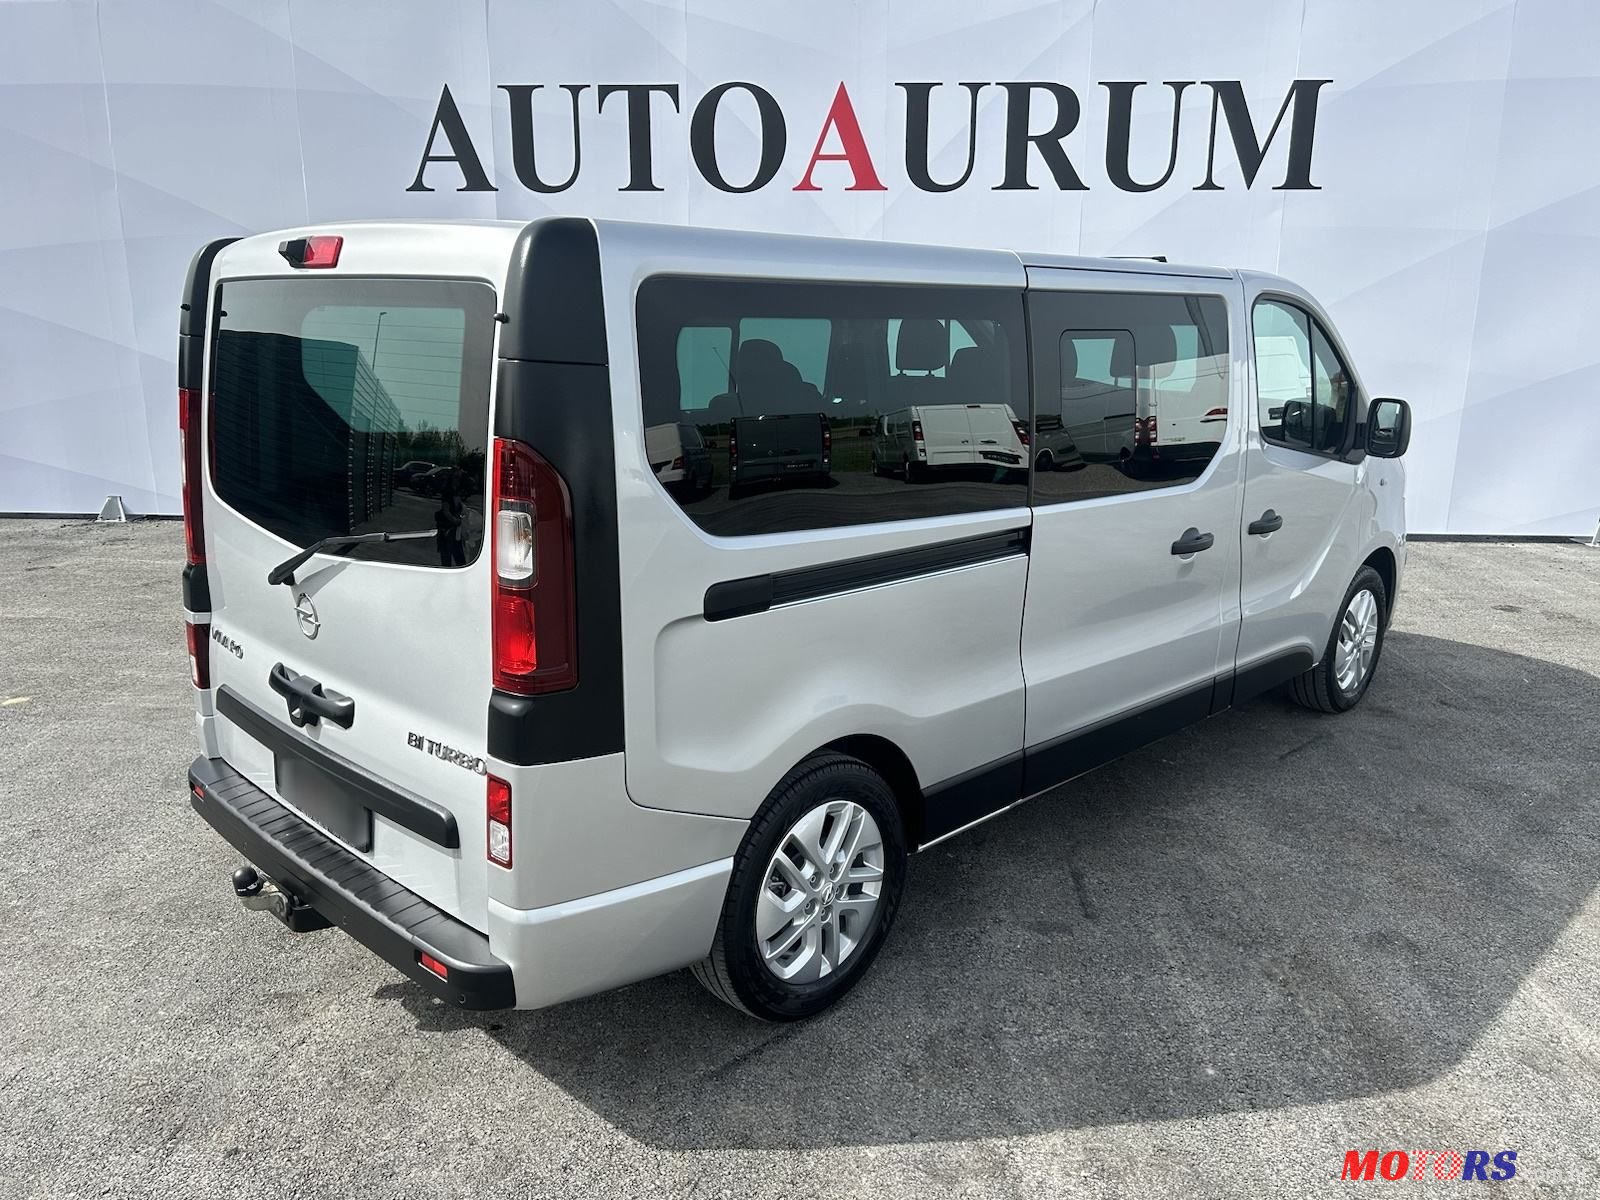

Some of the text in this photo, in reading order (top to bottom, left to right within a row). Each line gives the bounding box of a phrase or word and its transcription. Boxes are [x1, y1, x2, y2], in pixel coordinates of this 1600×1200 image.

[407, 79, 1334, 193] AUTOAURUM
[407, 731, 488, 776] BI TURBO
